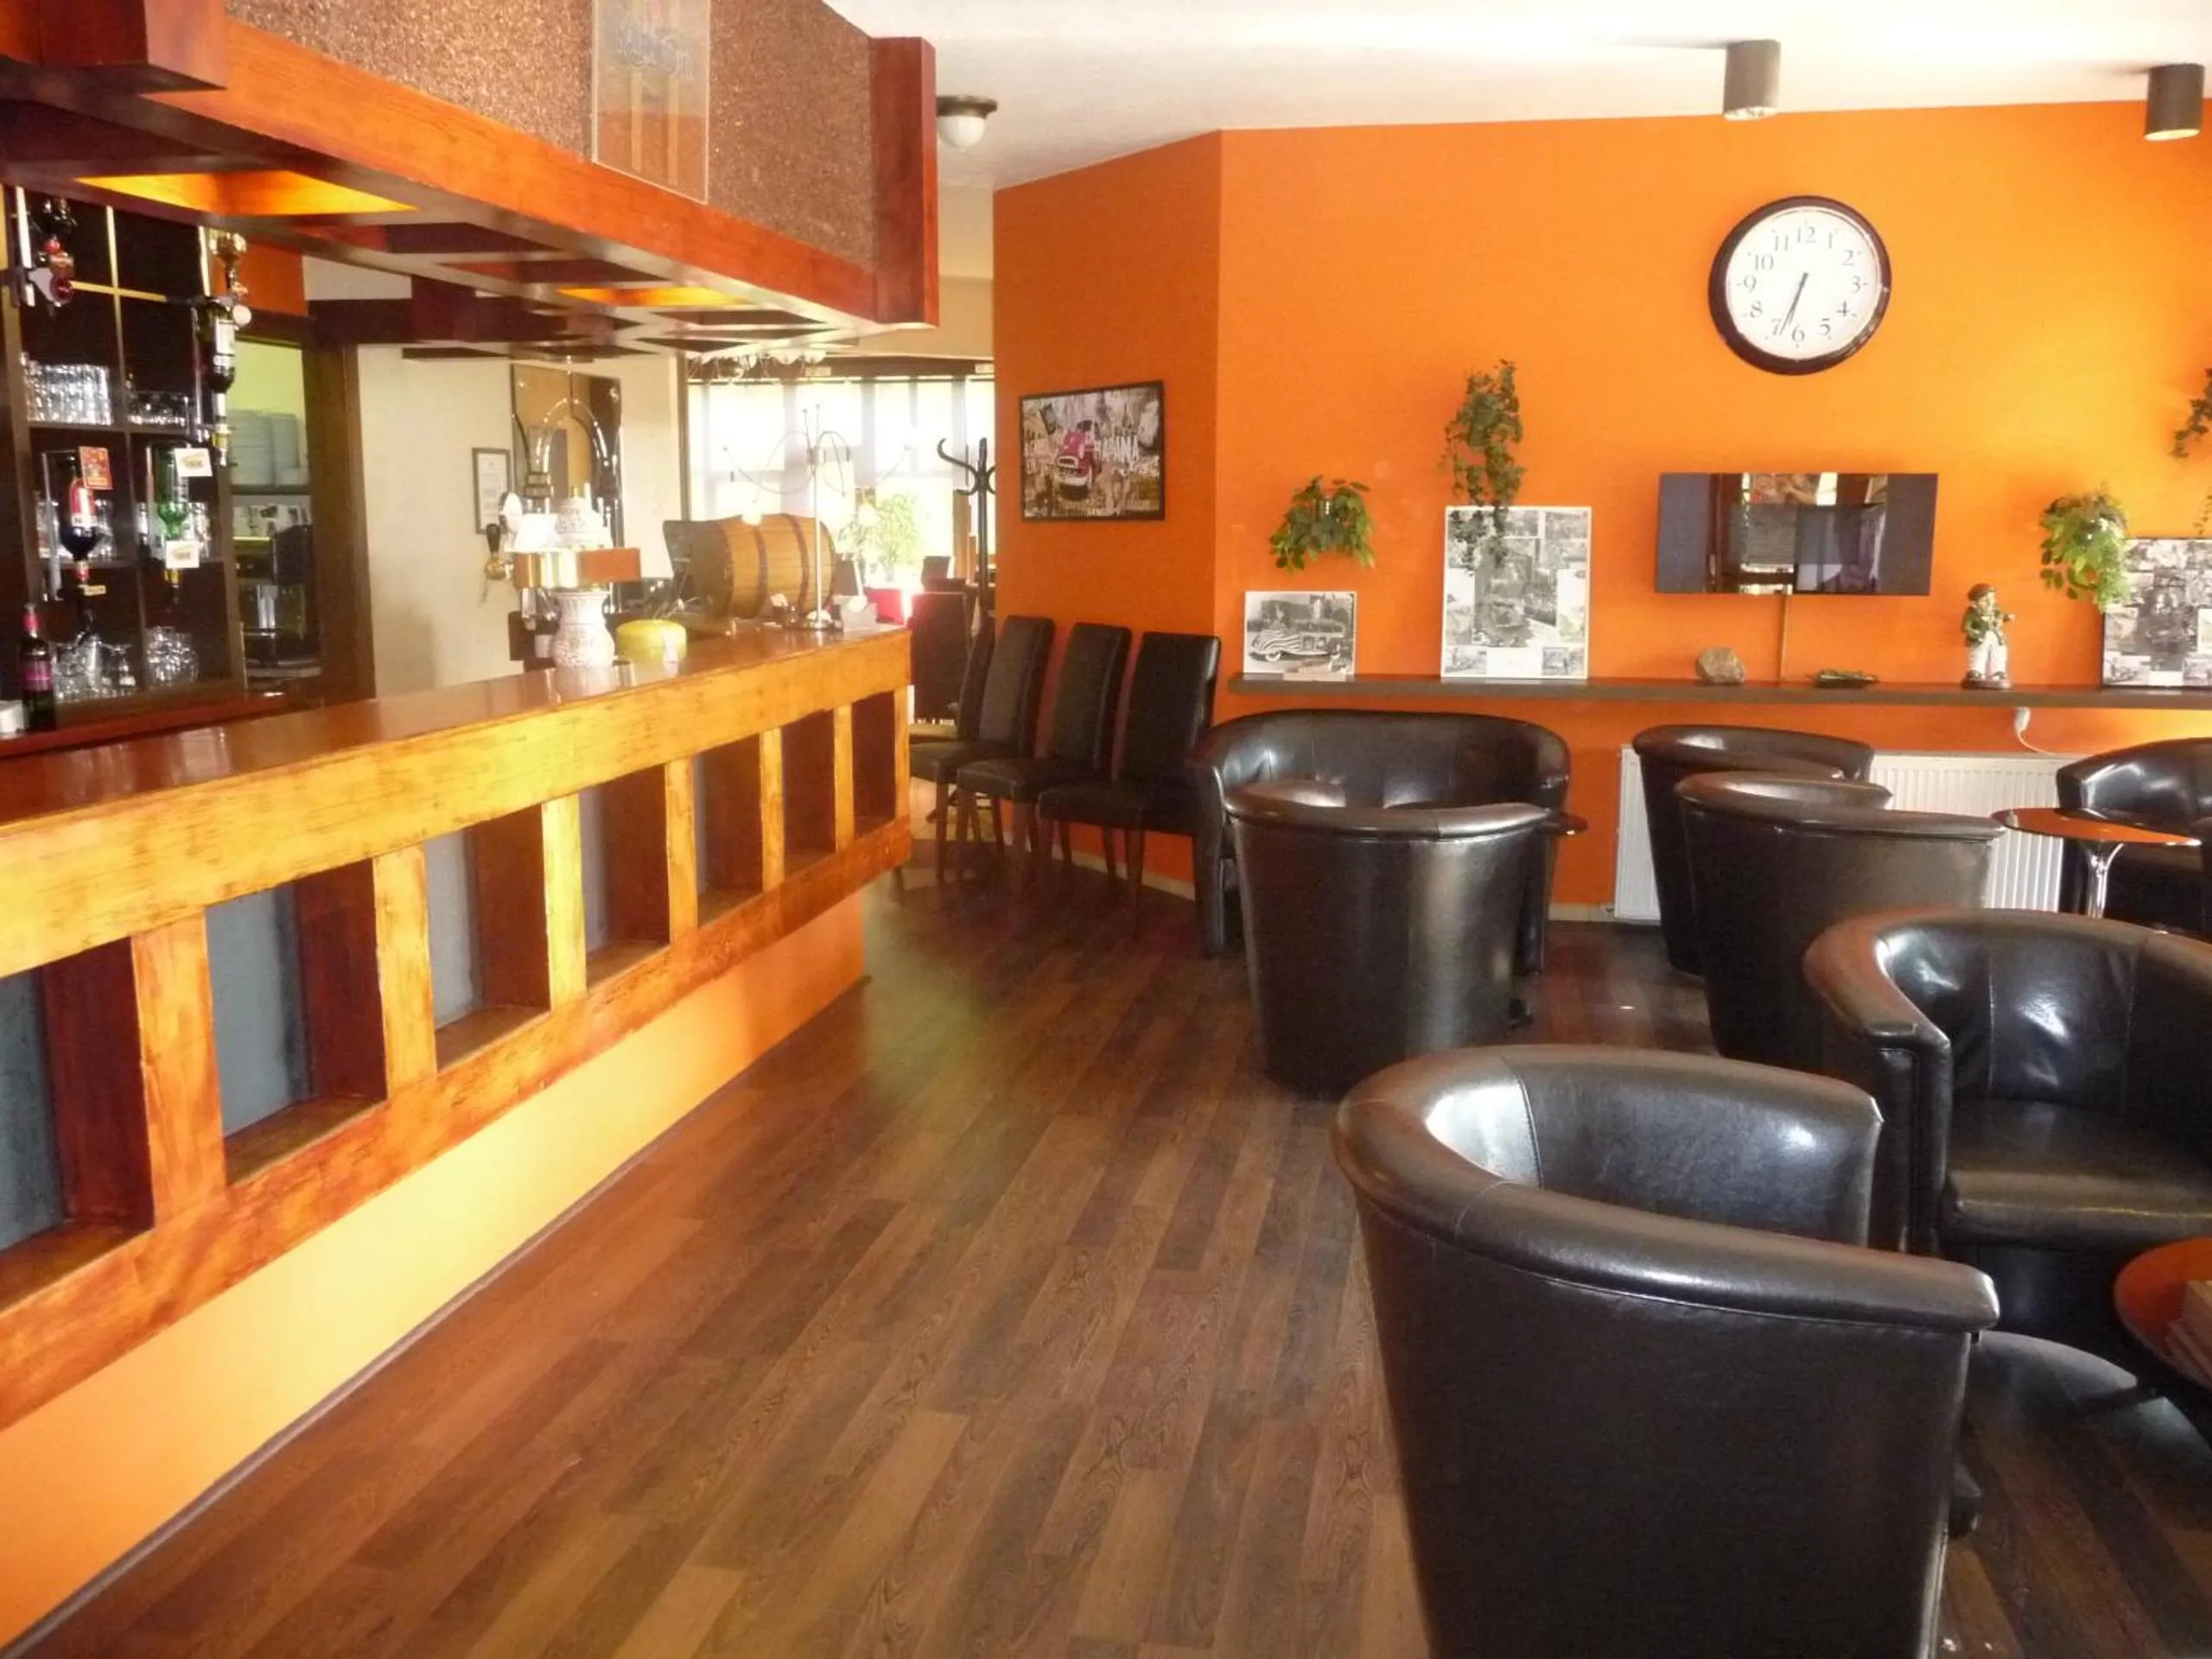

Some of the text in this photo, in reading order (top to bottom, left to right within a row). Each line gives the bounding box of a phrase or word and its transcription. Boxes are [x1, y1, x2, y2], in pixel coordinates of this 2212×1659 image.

[1775, 235, 1789, 251] 11
[1796, 226, 1815, 244] 12
[1755, 254, 1774, 271] 10
[1842, 250, 1853, 266] 2
[1744, 275, 1757, 293] 9
[1851, 276, 1861, 293] 3
[1750, 301, 1764, 318] 8
[1836, 300, 1849, 316] 4
[1771, 318, 1782, 335] 7
[1791, 325, 1805, 342] 6
[1819, 318, 1831, 335] 5
